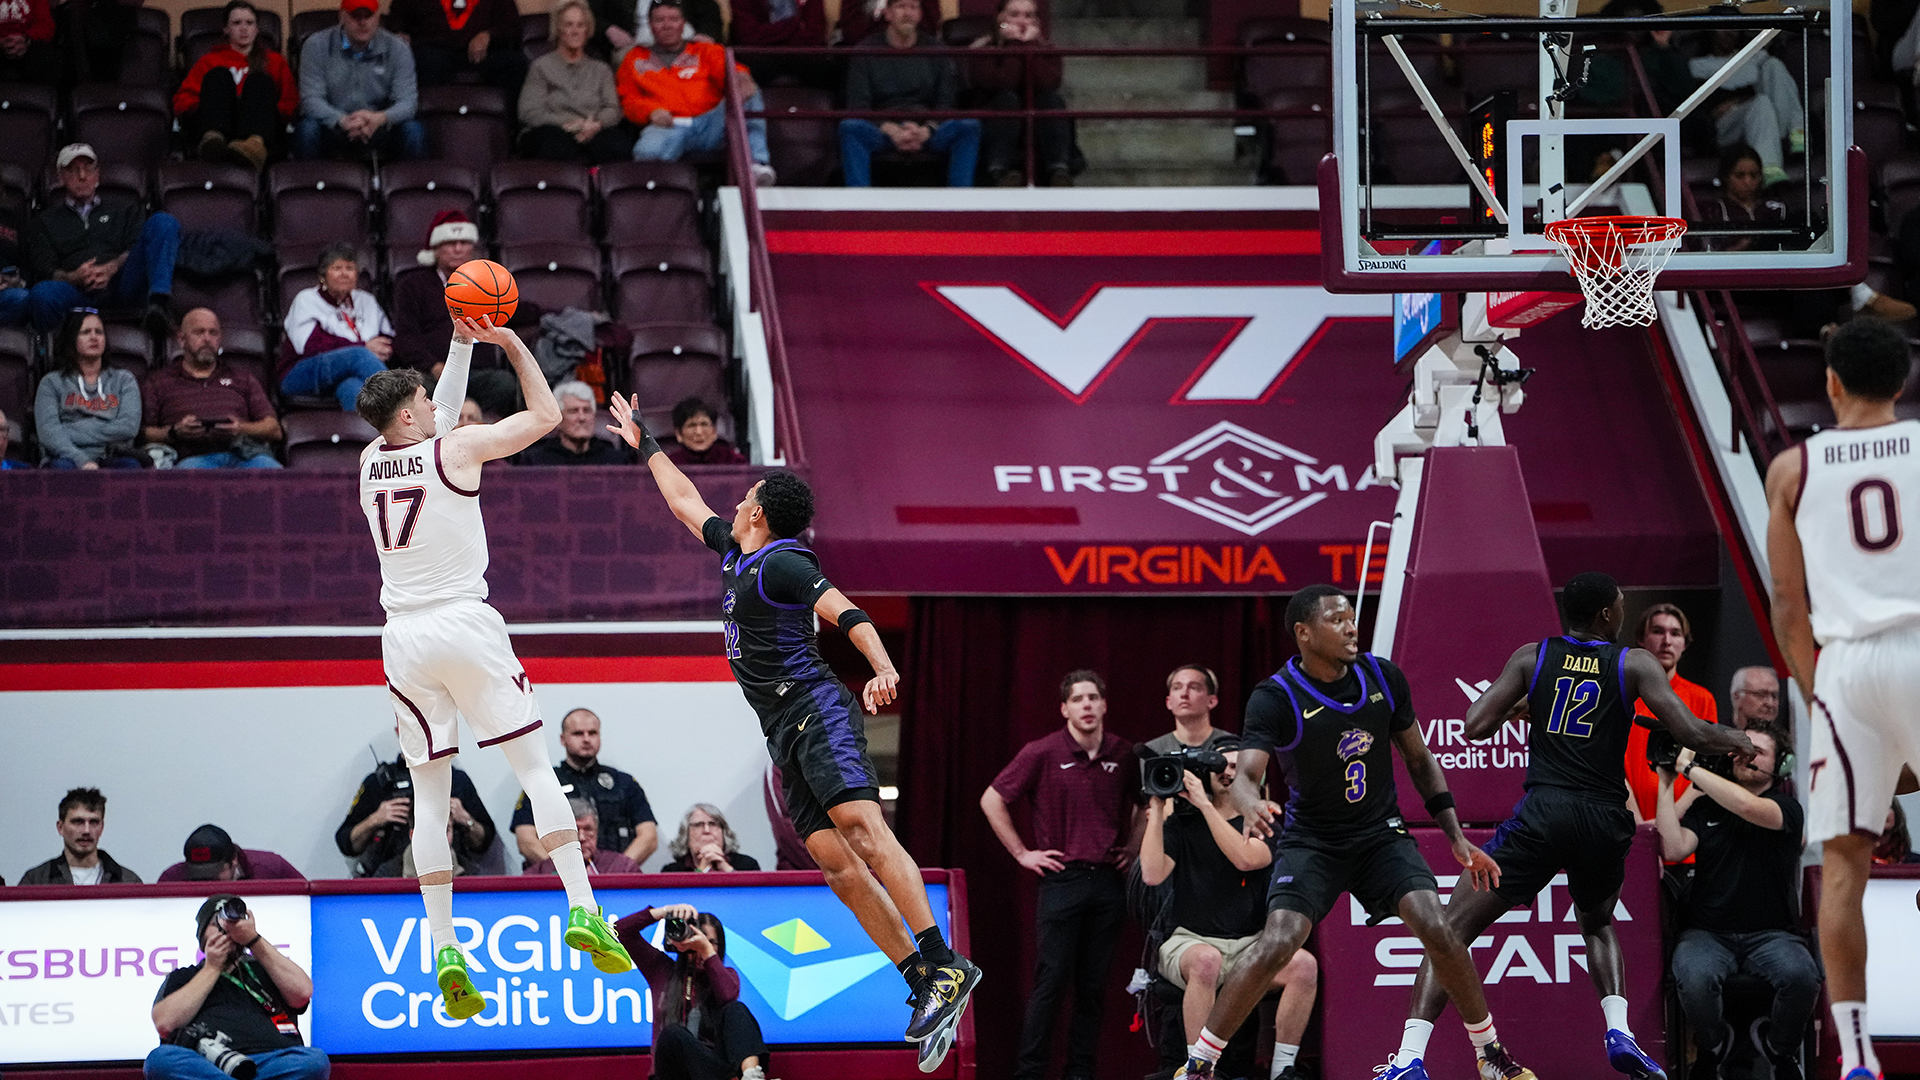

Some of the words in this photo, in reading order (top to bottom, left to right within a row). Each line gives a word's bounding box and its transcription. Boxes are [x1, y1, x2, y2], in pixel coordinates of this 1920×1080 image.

[1358, 259, 1406, 271] SPALDING
[1825, 437, 1910, 464] BEDFORD
[369, 456, 423, 480] AVDALAS
[993, 465, 1189, 493] FIRST
[1294, 464, 1400, 492] MA
[373, 485, 427, 551] 17
[1846, 475, 1904, 555] 0
[1044, 545, 1287, 585] VIRGINIA
[1319, 544, 1391, 584] TE
[1562, 653, 1600, 675] DADA
[1546, 676, 1601, 738] 12
[1430, 747, 1488, 769] redit
[1492, 745, 1530, 769] Uni
[1345, 759, 1367, 804] 3
[0, 946, 180, 981] SBURG
